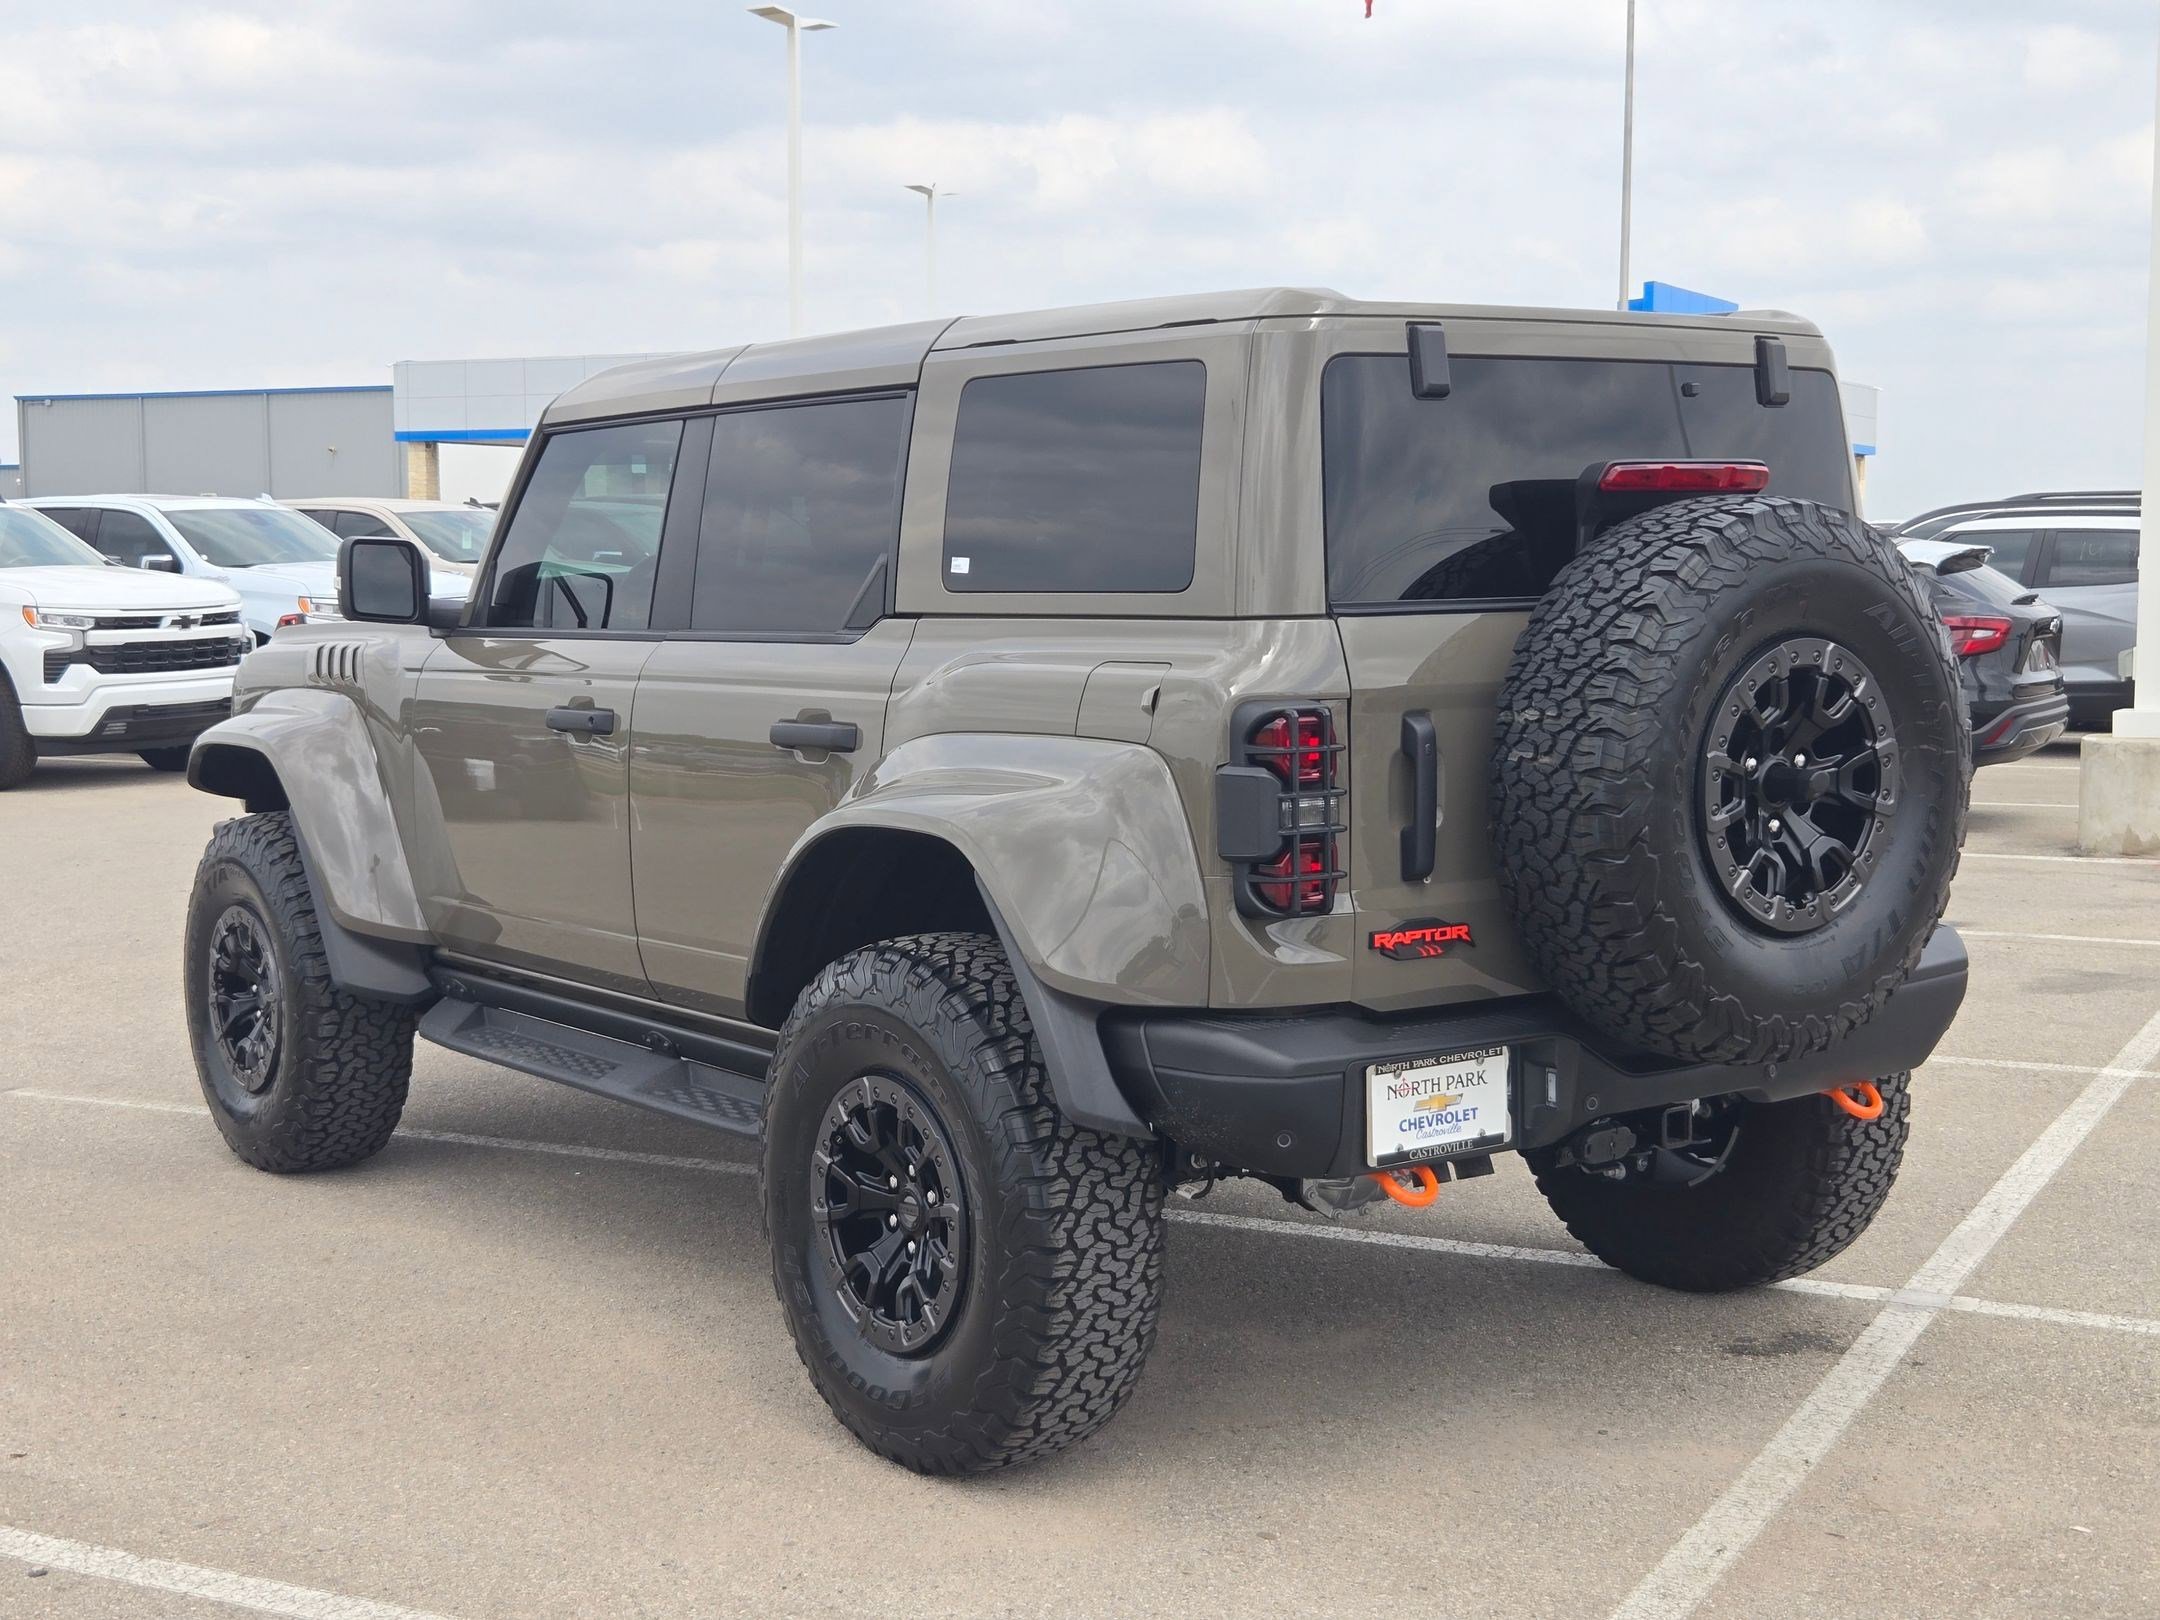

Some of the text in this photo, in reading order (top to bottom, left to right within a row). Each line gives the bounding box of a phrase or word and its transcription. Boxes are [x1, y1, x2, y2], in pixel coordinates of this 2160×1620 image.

[1373, 924, 1471, 950] RAPTOR
[1376, 1047, 1502, 1075] NORTH PARK CHEVROLET
[1387, 1070, 1488, 1101] NORTH PARK
[1399, 1107, 1478, 1132] CHEVROLET
[1416, 1123, 1462, 1140] Castroville
[1409, 1140, 1474, 1160] CASTROVILLE
